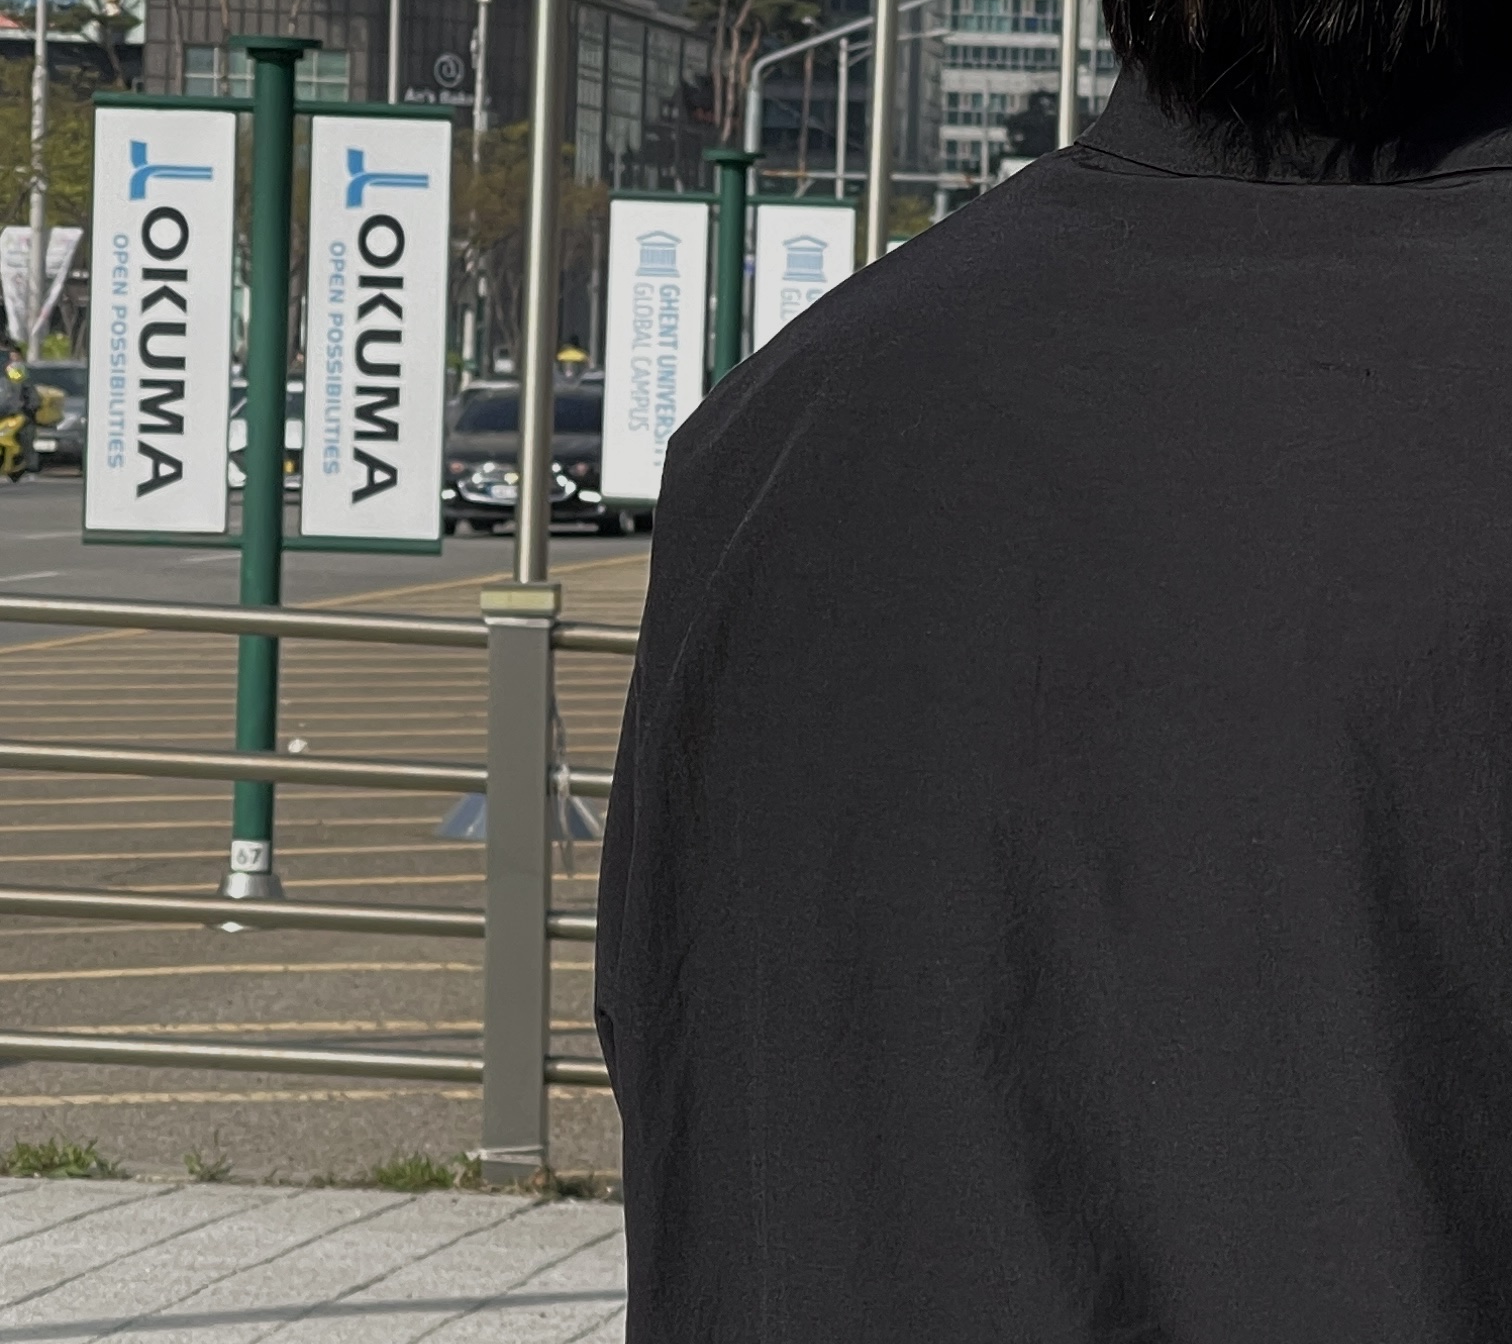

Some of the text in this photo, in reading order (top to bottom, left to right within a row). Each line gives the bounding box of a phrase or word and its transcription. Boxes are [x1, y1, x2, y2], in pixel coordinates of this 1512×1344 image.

[108, 234, 129, 469] OPEN POSSIBILITIES
[136, 206, 189, 499] OKUMA
[323, 241, 346, 475] OPEN POSSIBILITIES
[351, 214, 405, 505] OKUMA
[628, 282, 654, 432] GLOBAL CAMPUS
[658, 283, 681, 351] GHENT
